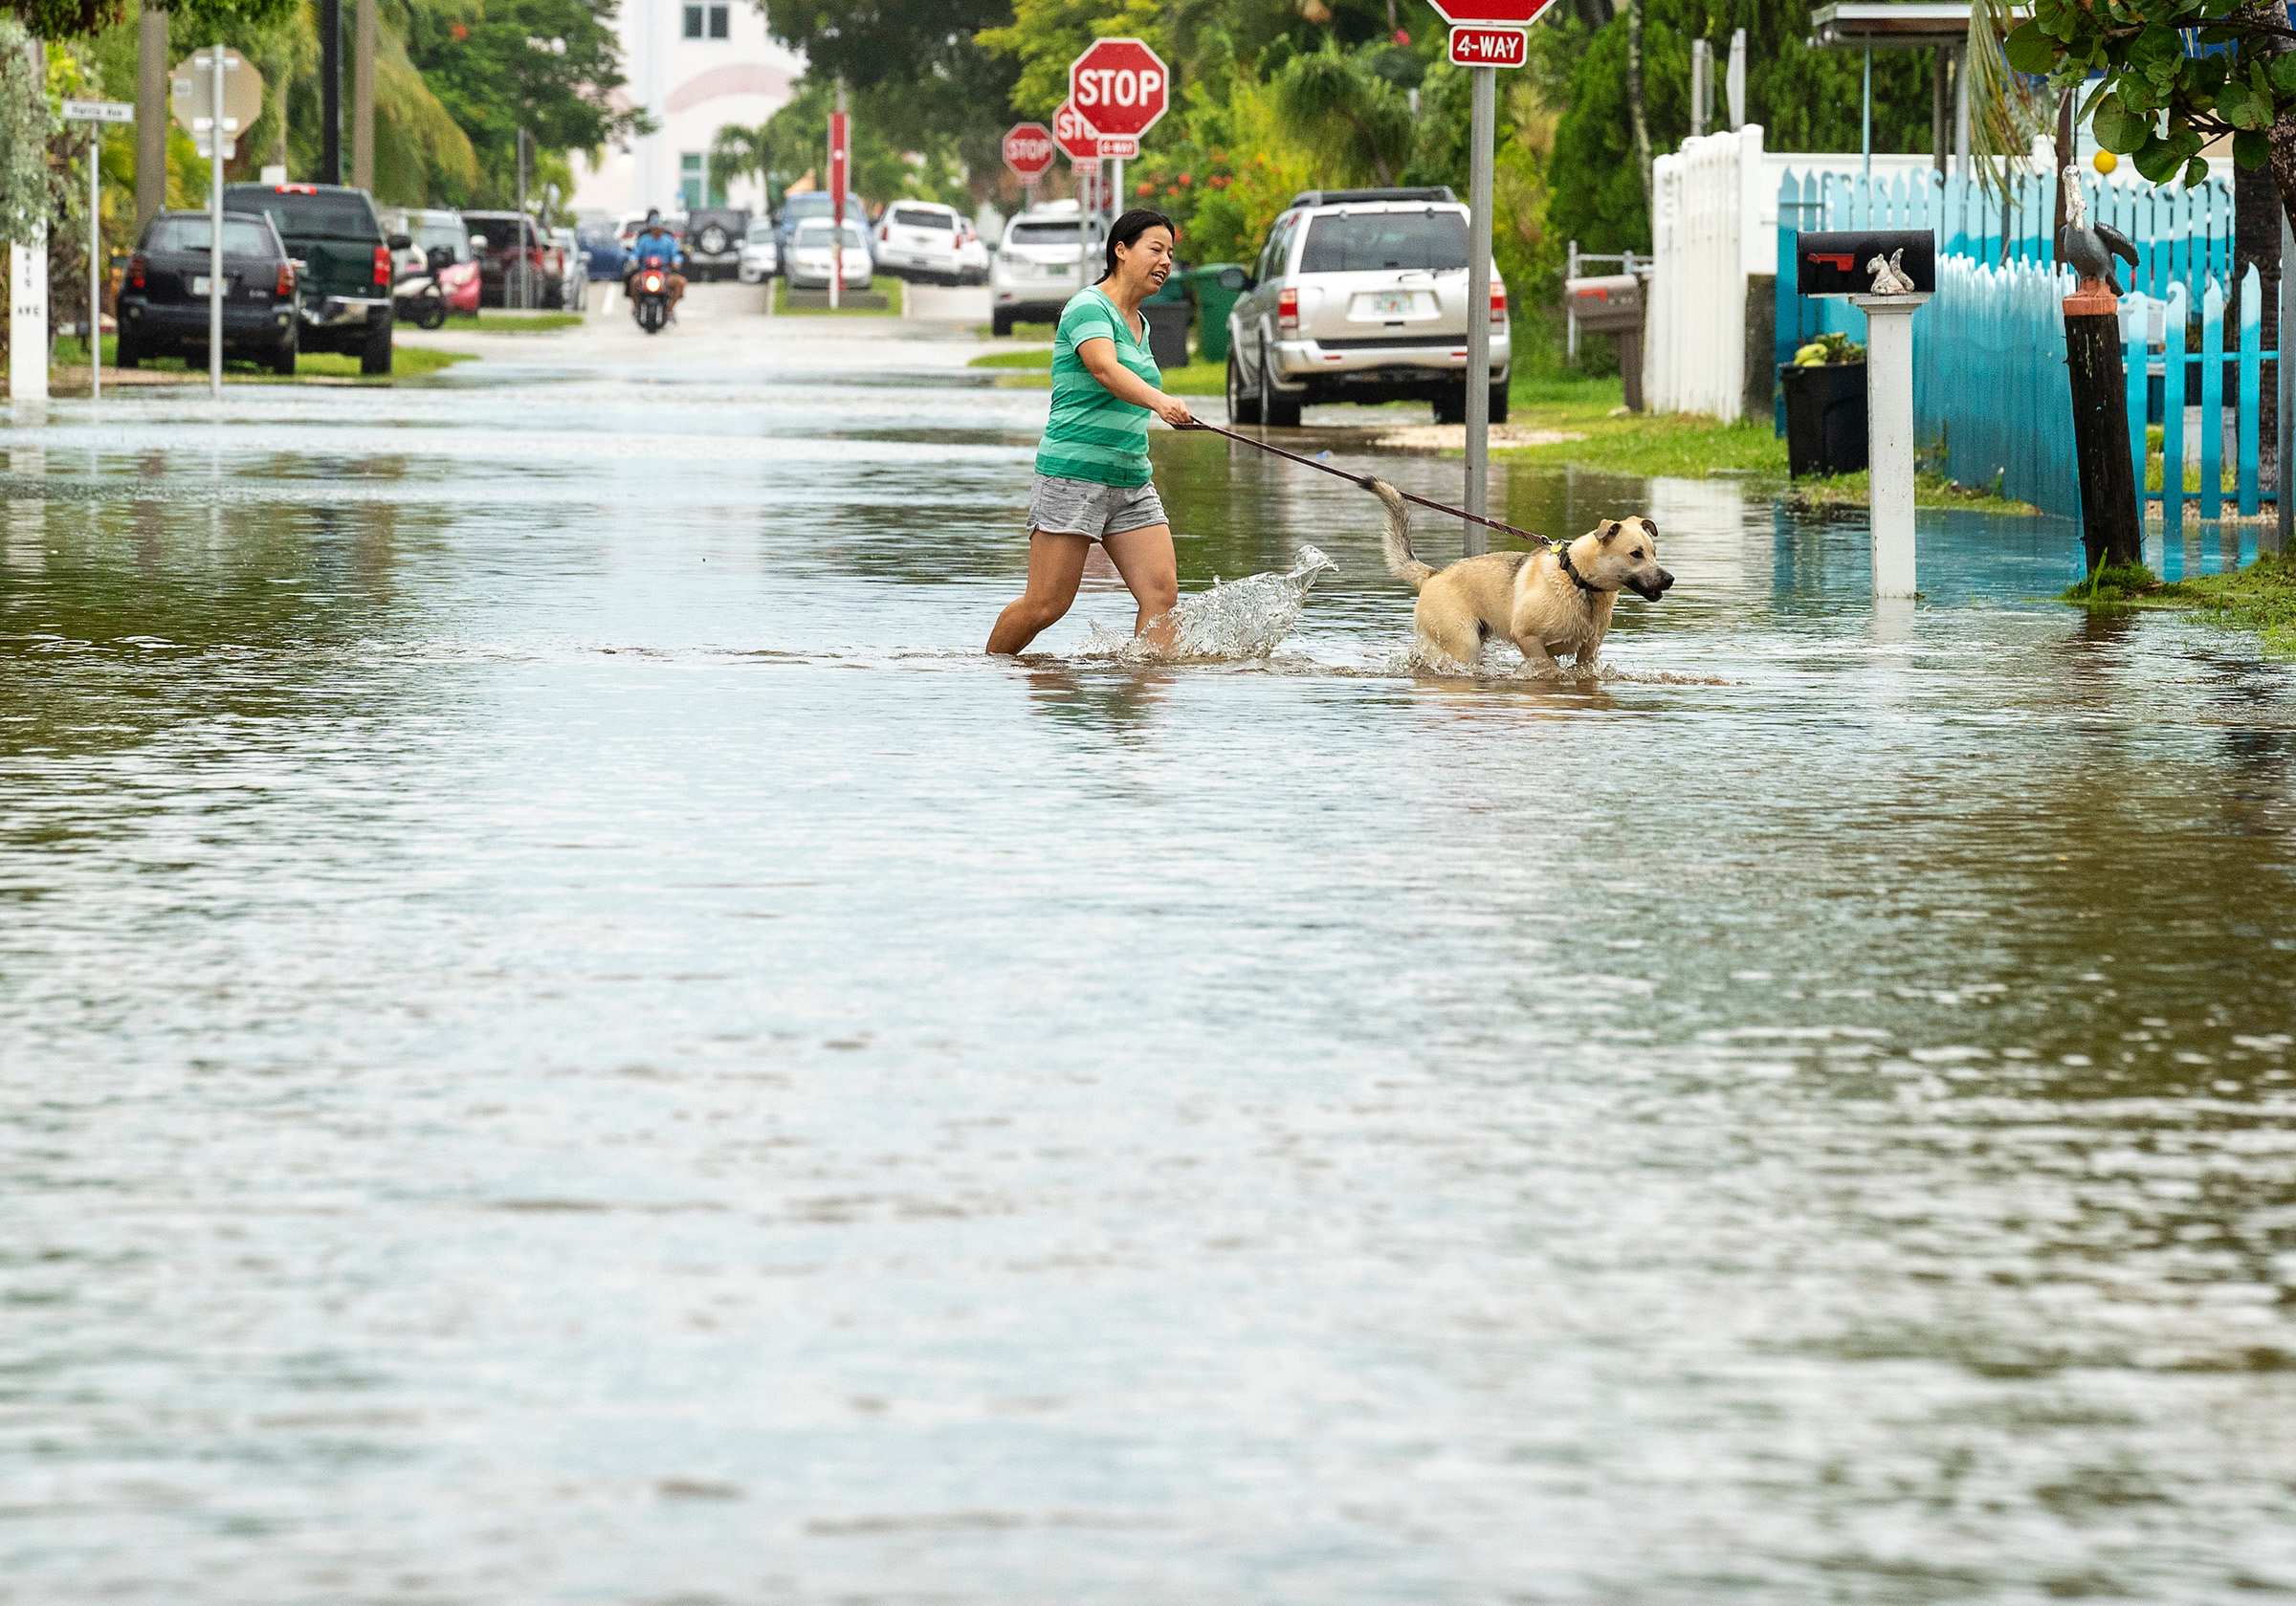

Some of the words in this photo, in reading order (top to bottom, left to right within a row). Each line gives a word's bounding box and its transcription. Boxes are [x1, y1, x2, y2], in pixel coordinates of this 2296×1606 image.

[1457, 34, 1519, 58] 4-WAY
[1077, 69, 1161, 107] STOP
[1059, 114, 1098, 140] STO
[1009, 139, 1050, 161] STOP
